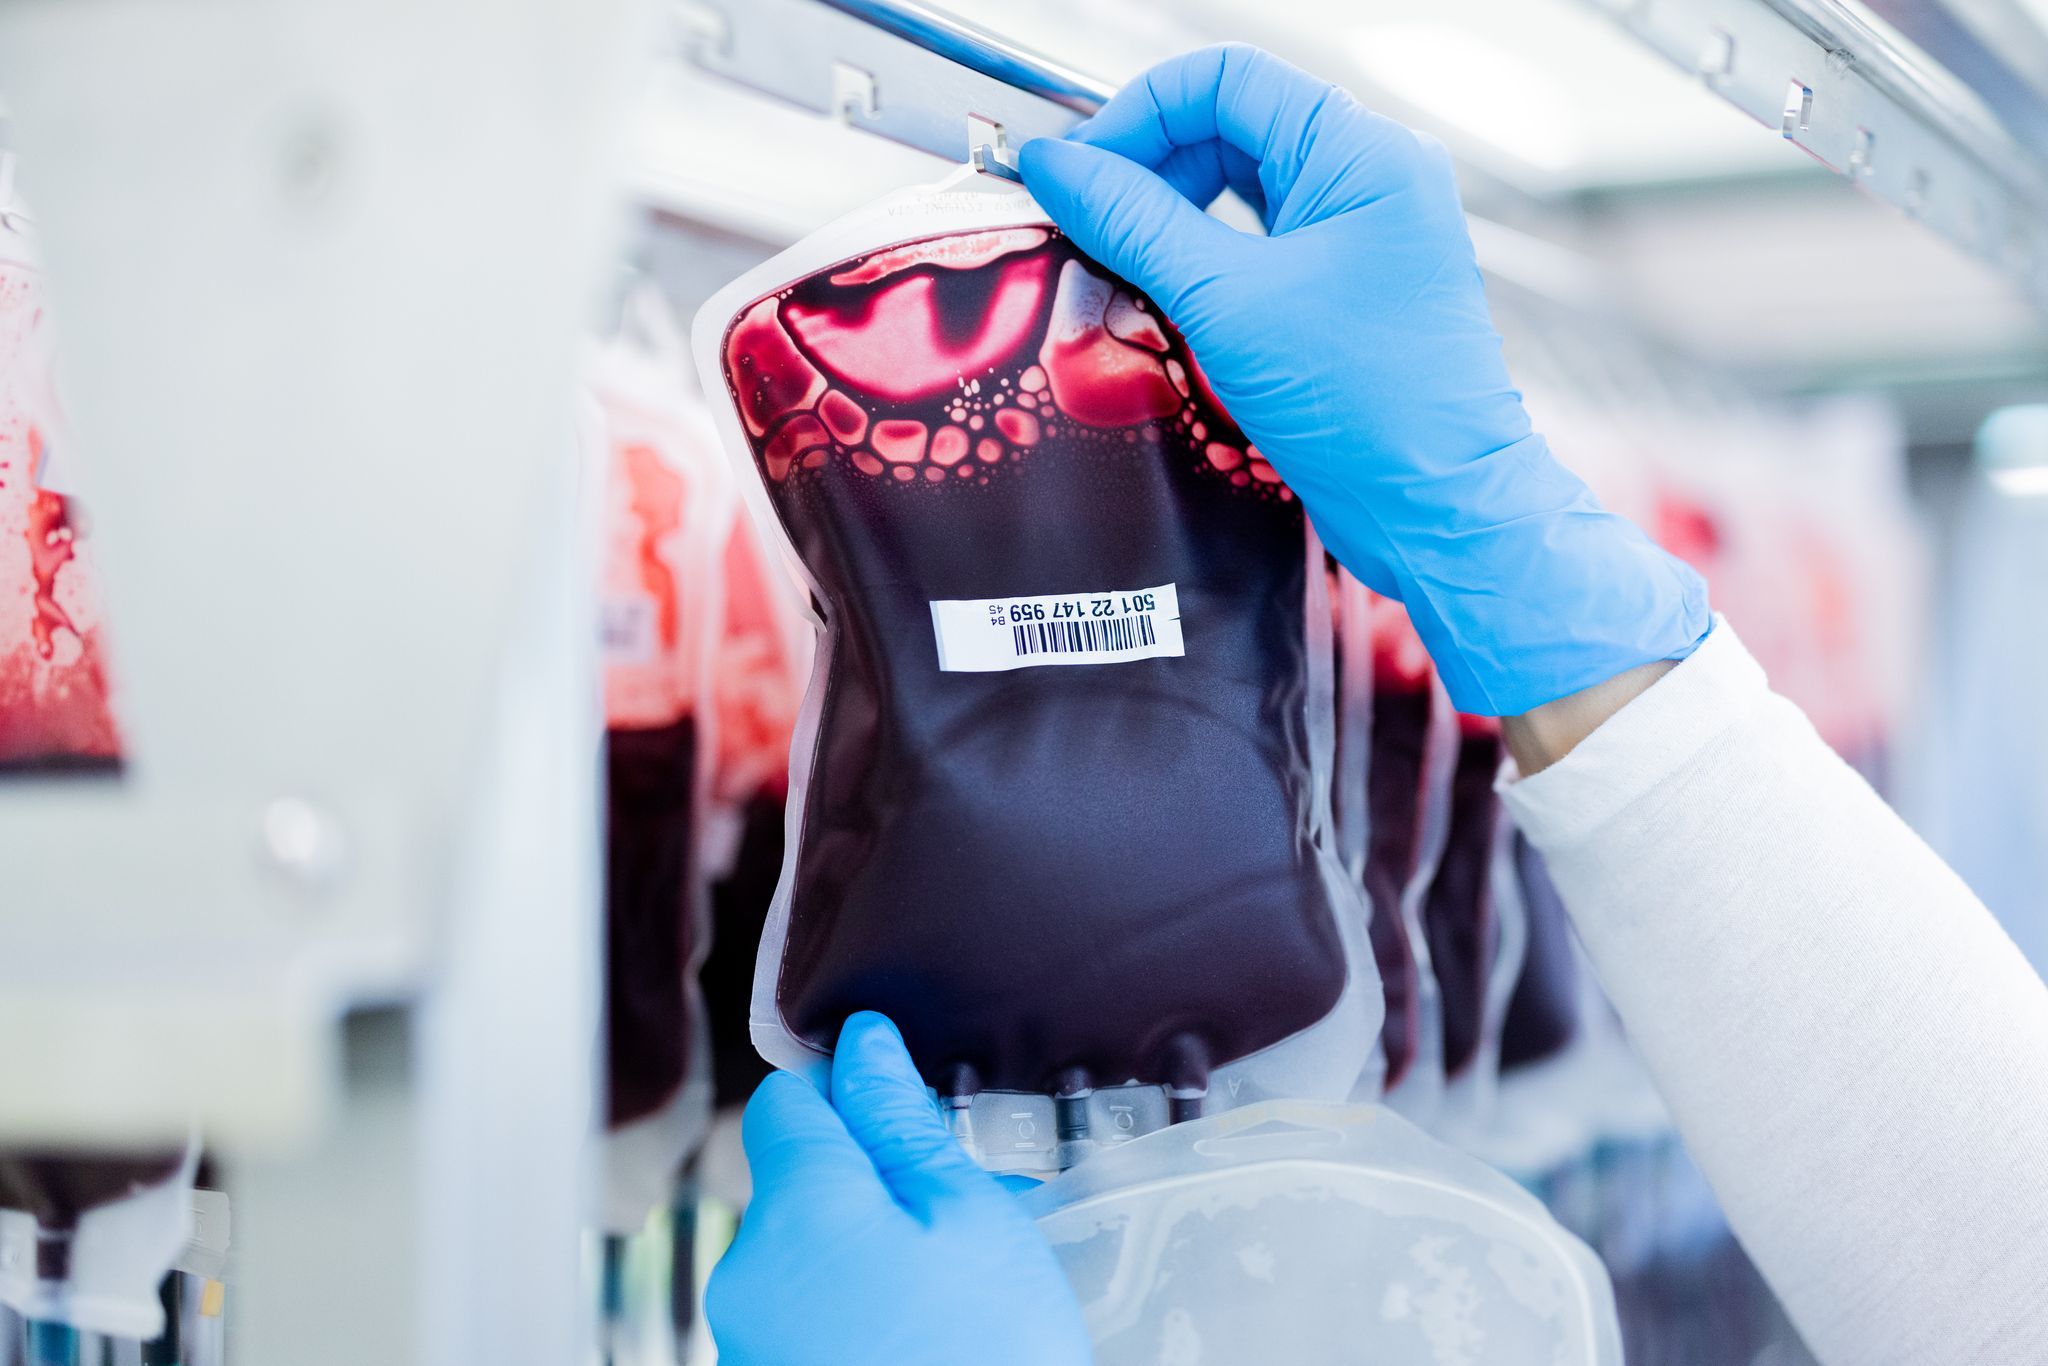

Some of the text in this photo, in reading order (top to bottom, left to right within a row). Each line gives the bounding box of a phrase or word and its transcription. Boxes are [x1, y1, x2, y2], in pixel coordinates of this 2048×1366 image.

[989, 604, 1004, 614] 45
[1010, 594, 1156, 622] 501 22 147 959
